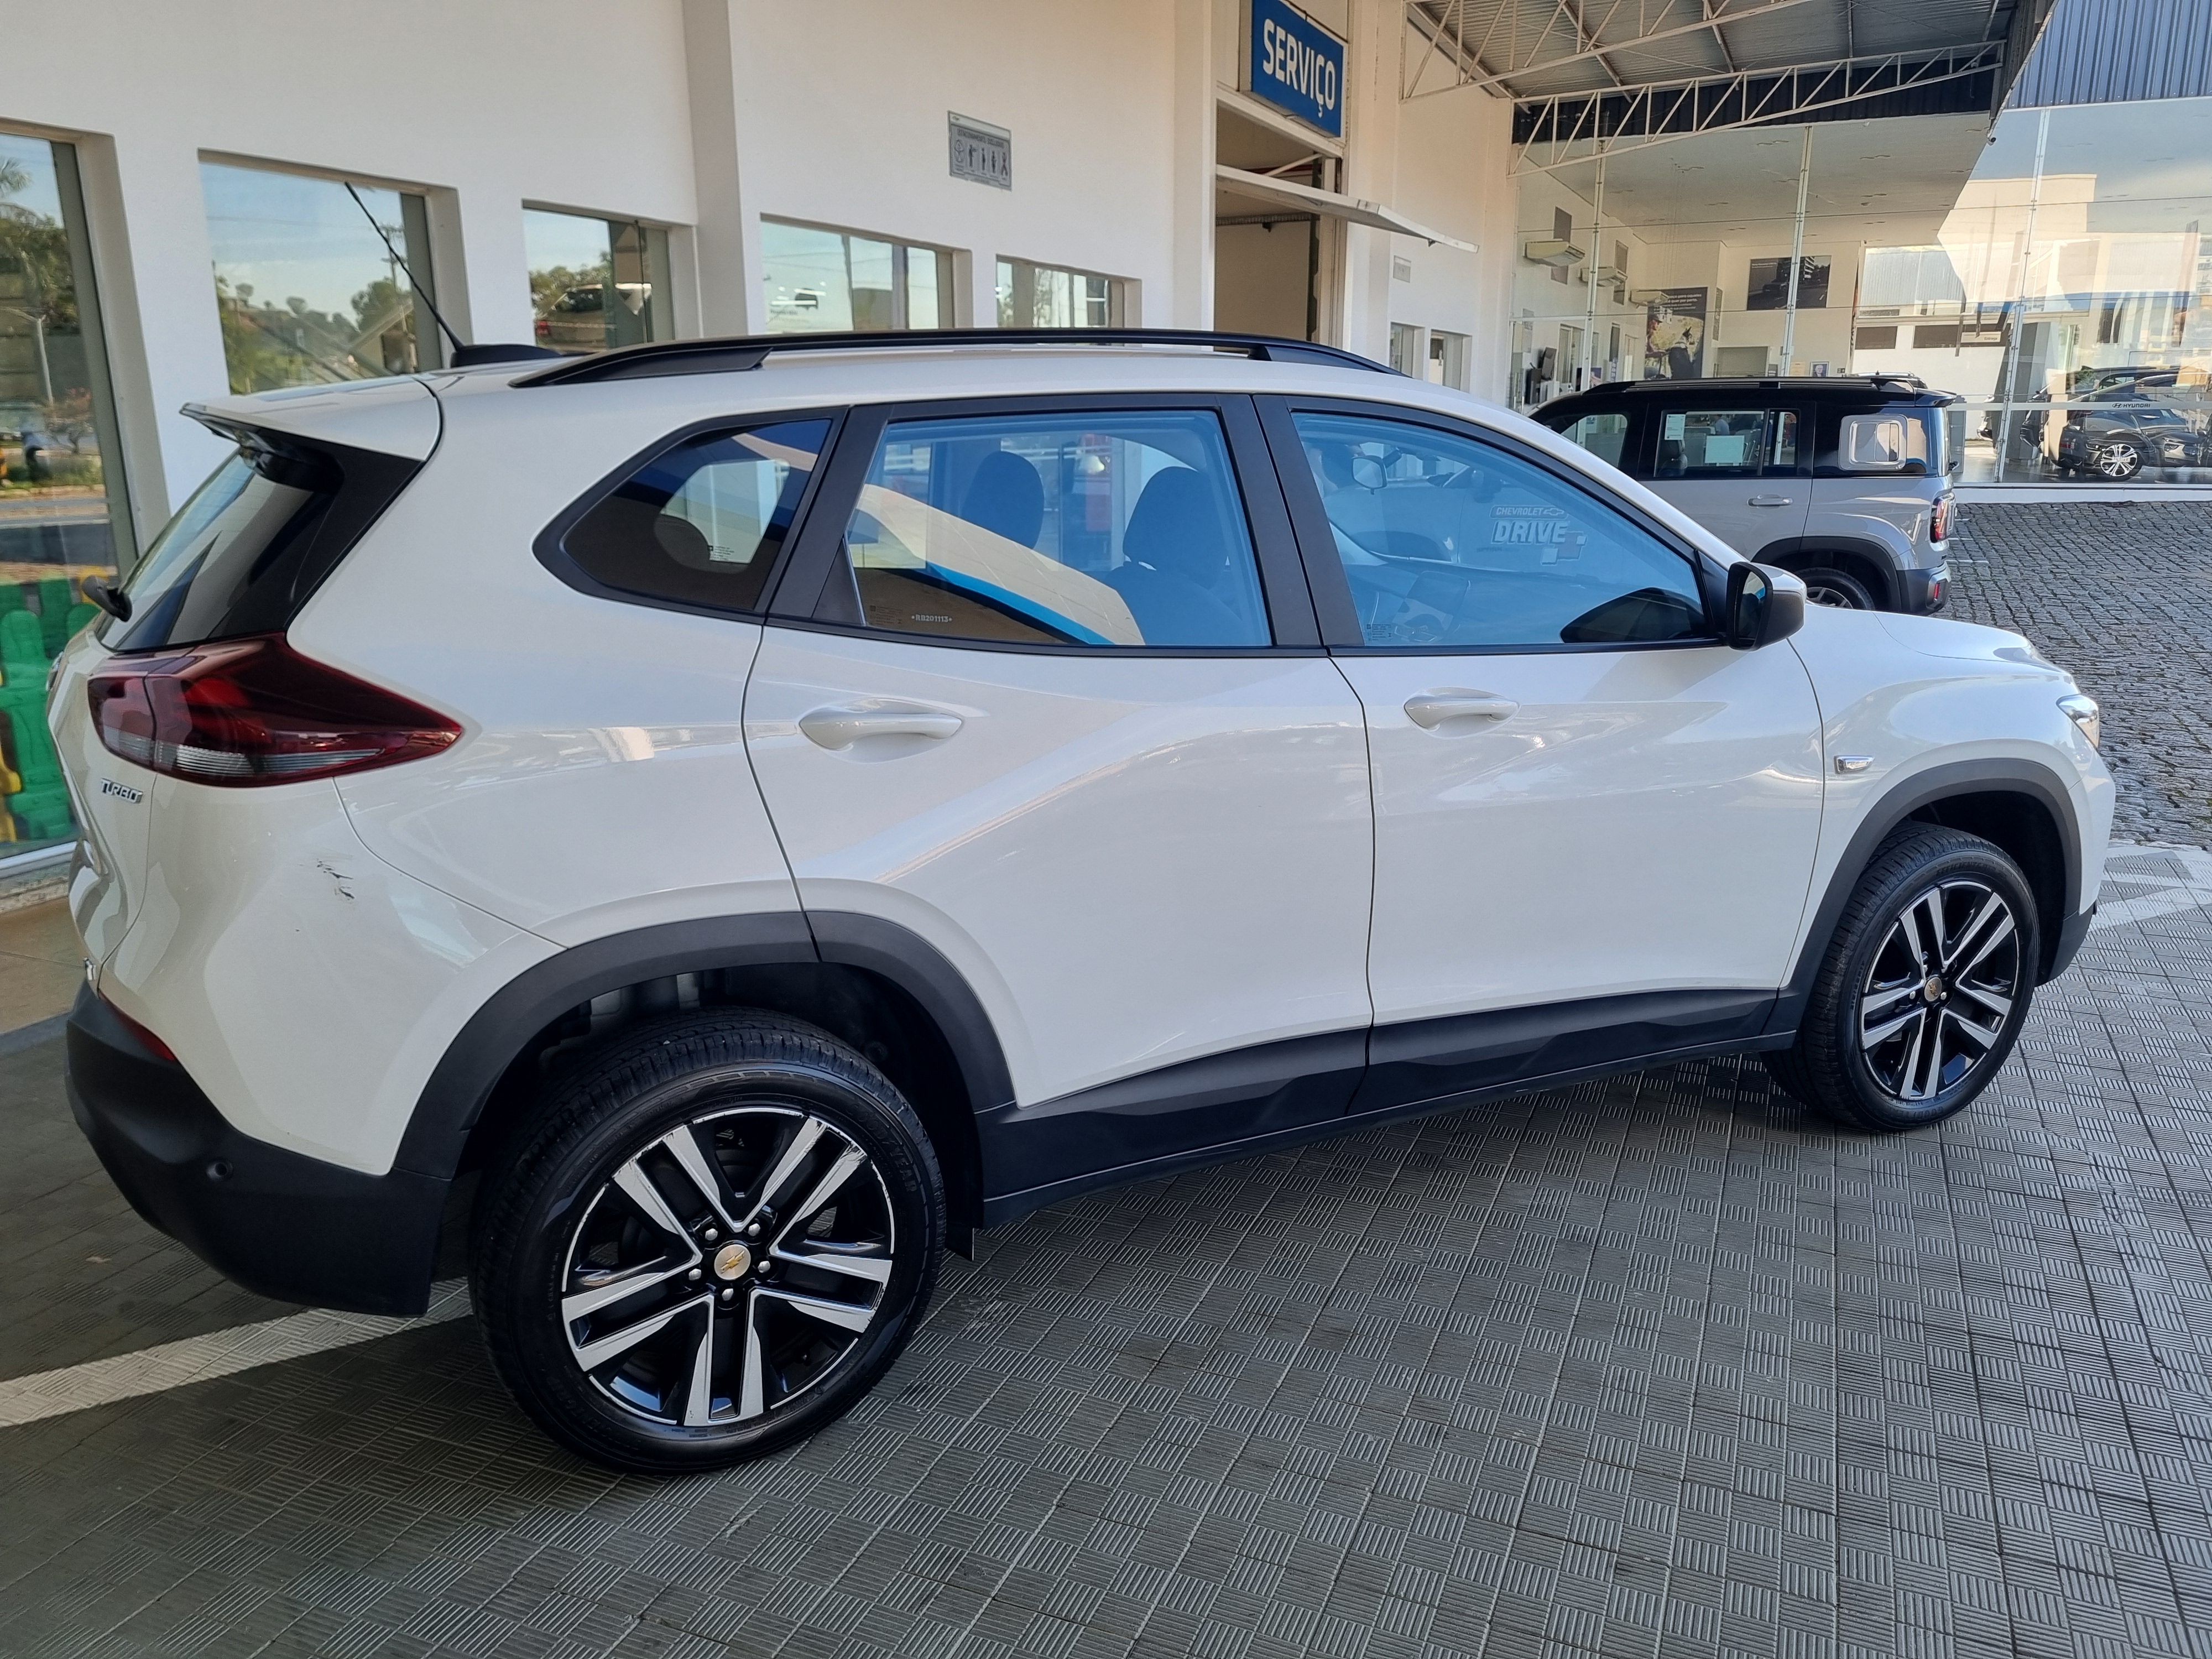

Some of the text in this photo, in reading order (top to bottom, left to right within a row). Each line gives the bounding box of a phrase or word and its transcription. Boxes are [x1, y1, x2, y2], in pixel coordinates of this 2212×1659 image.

[1262, 18, 1336, 118] SERVIÇO
[1496, 507, 1544, 516] CHEVROLET
[1491, 520, 1569, 545] DRIVE
[101, 778, 144, 804] TURBO
